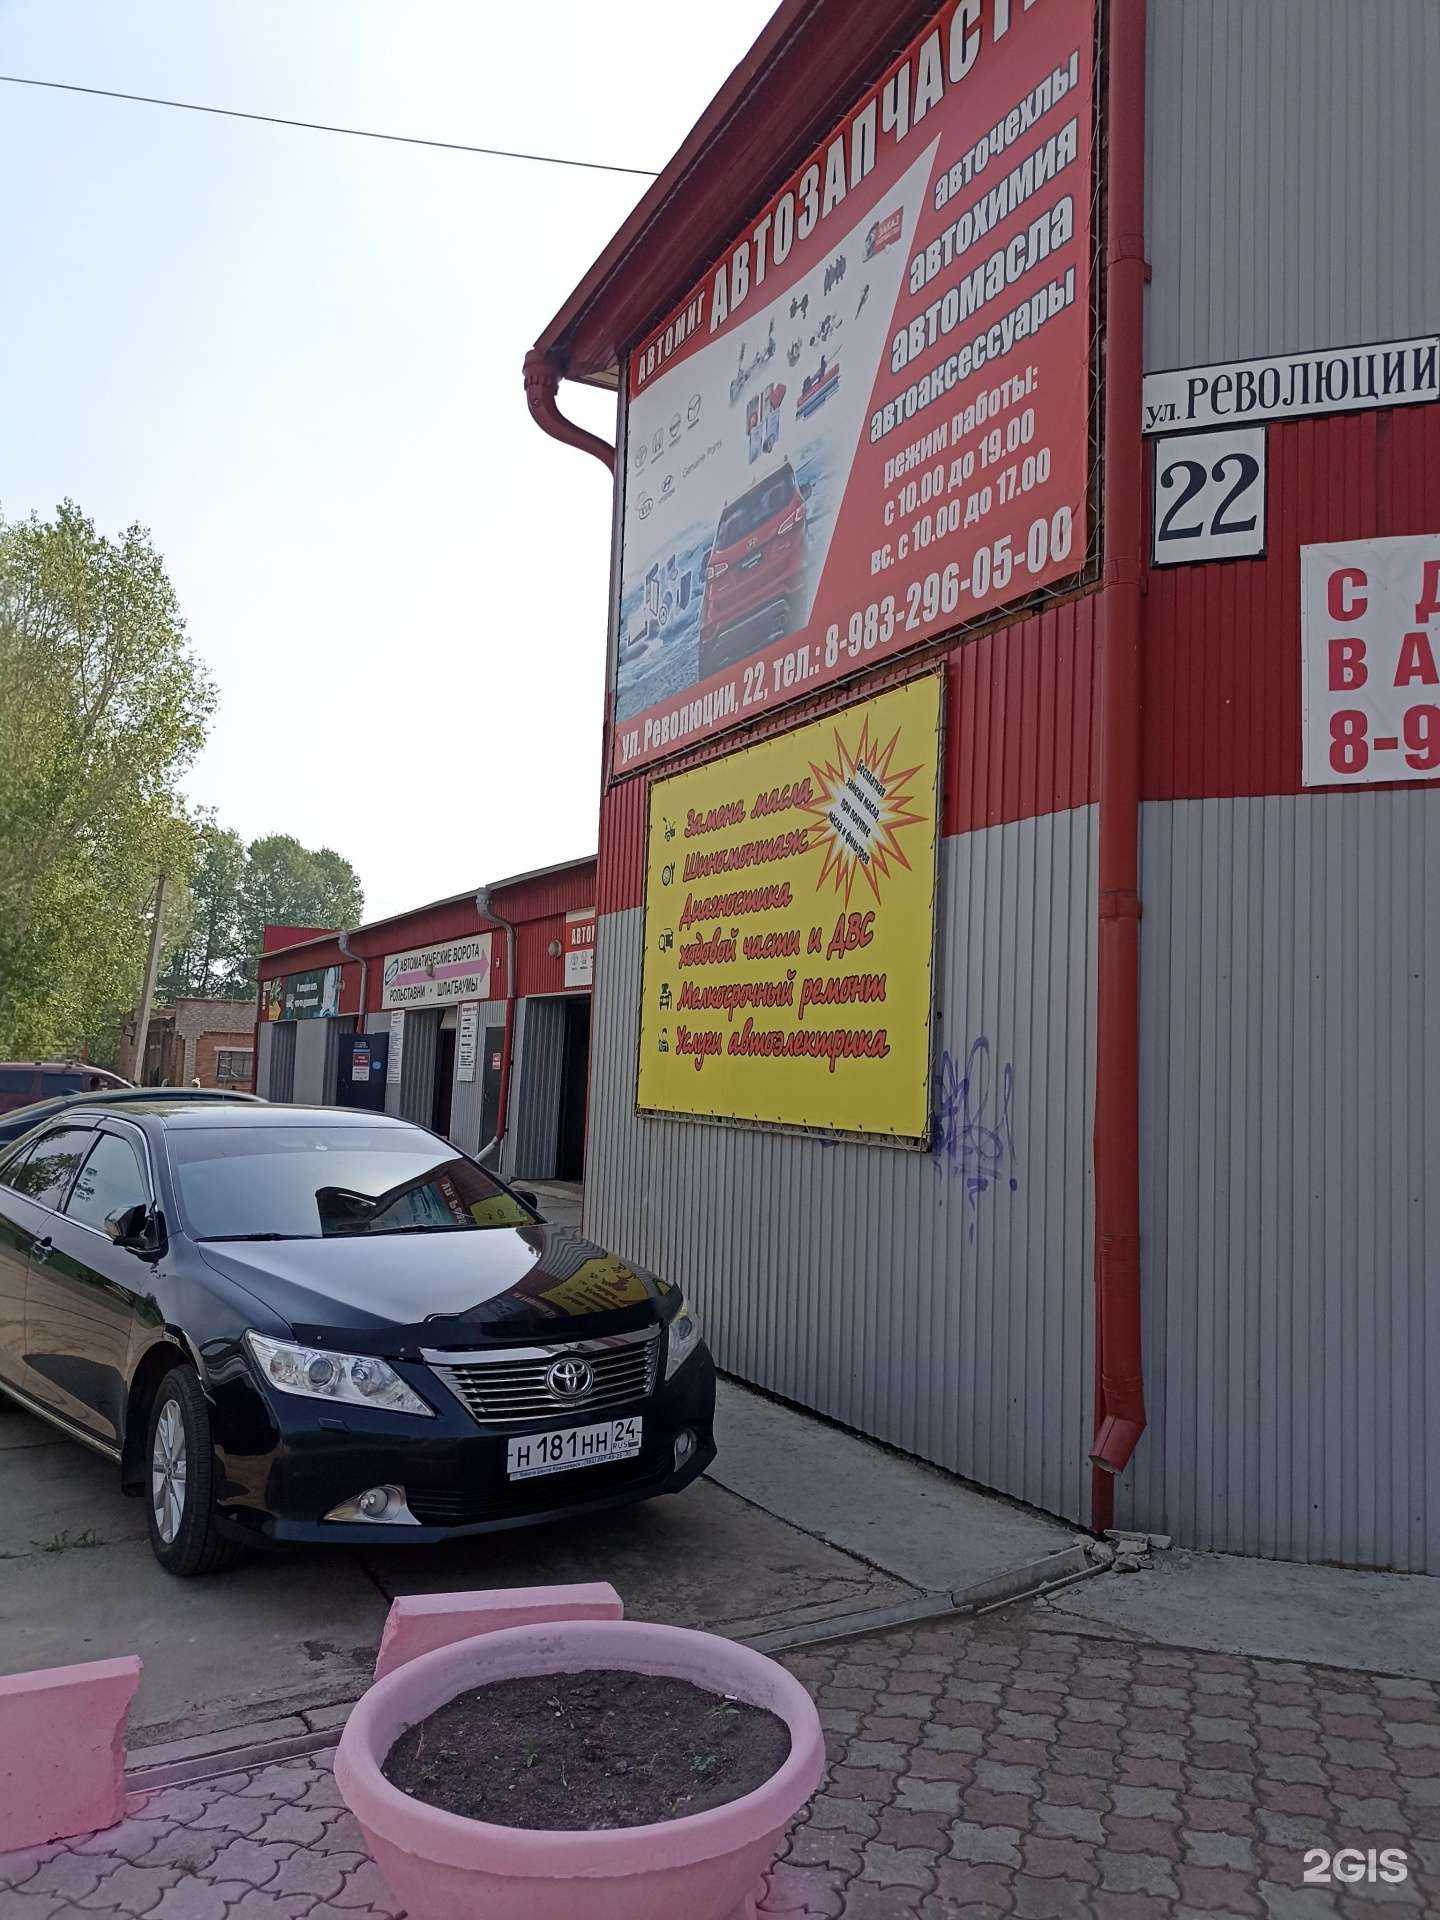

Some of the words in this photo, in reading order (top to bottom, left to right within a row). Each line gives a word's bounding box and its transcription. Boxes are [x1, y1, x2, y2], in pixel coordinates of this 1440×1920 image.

[709, 0, 1038, 335] АВТОЗАПЧАС
[933, 48, 1081, 211] авточехлы
[909, 115, 1079, 296] автохимия
[890, 196, 1075, 374] автомасла
[870, 266, 1076, 443] автоаксессуары
[884, 422, 948, 489] режим
[951, 365, 1040, 446] работы:
[884, 501, 895, 526] с
[898, 464, 944, 517] 10.00
[948, 451, 975, 493] до
[978, 408, 1035, 469] 19.00
[1144, 402, 1181, 430] ул.
[871, 544, 895, 576] вс.
[912, 499, 961, 551] 10.00
[964, 486, 992, 528] до
[996, 447, 1050, 505] 17.00
[1158, 453, 1260, 542] 22
[621, 729, 641, 764] ул.
[644, 681, 739, 752] Революции,
[743, 661, 768, 707] 22,
[824, 505, 1074, 668] 8-983-296-05-00
[682, 828, 810, 882] Шиномонтаж
[684, 808, 747, 838] Замена
[750, 777, 814, 819] масла
[399, 948, 452, 972] АВТОМАТИЧЕСКИЕ
[453, 944, 480, 962] ВОРОТА
[678, 882, 793, 932] Диагностика
[678, 927, 740, 970] ходовой
[742, 930, 800, 961] части
[806, 927, 823, 954] и
[826, 911, 876, 961] ДВС
[675, 1025, 723, 1072] Услуги
[727, 1017, 891, 1074] автоэлектрика
[797, 973, 887, 1021] ремонт
